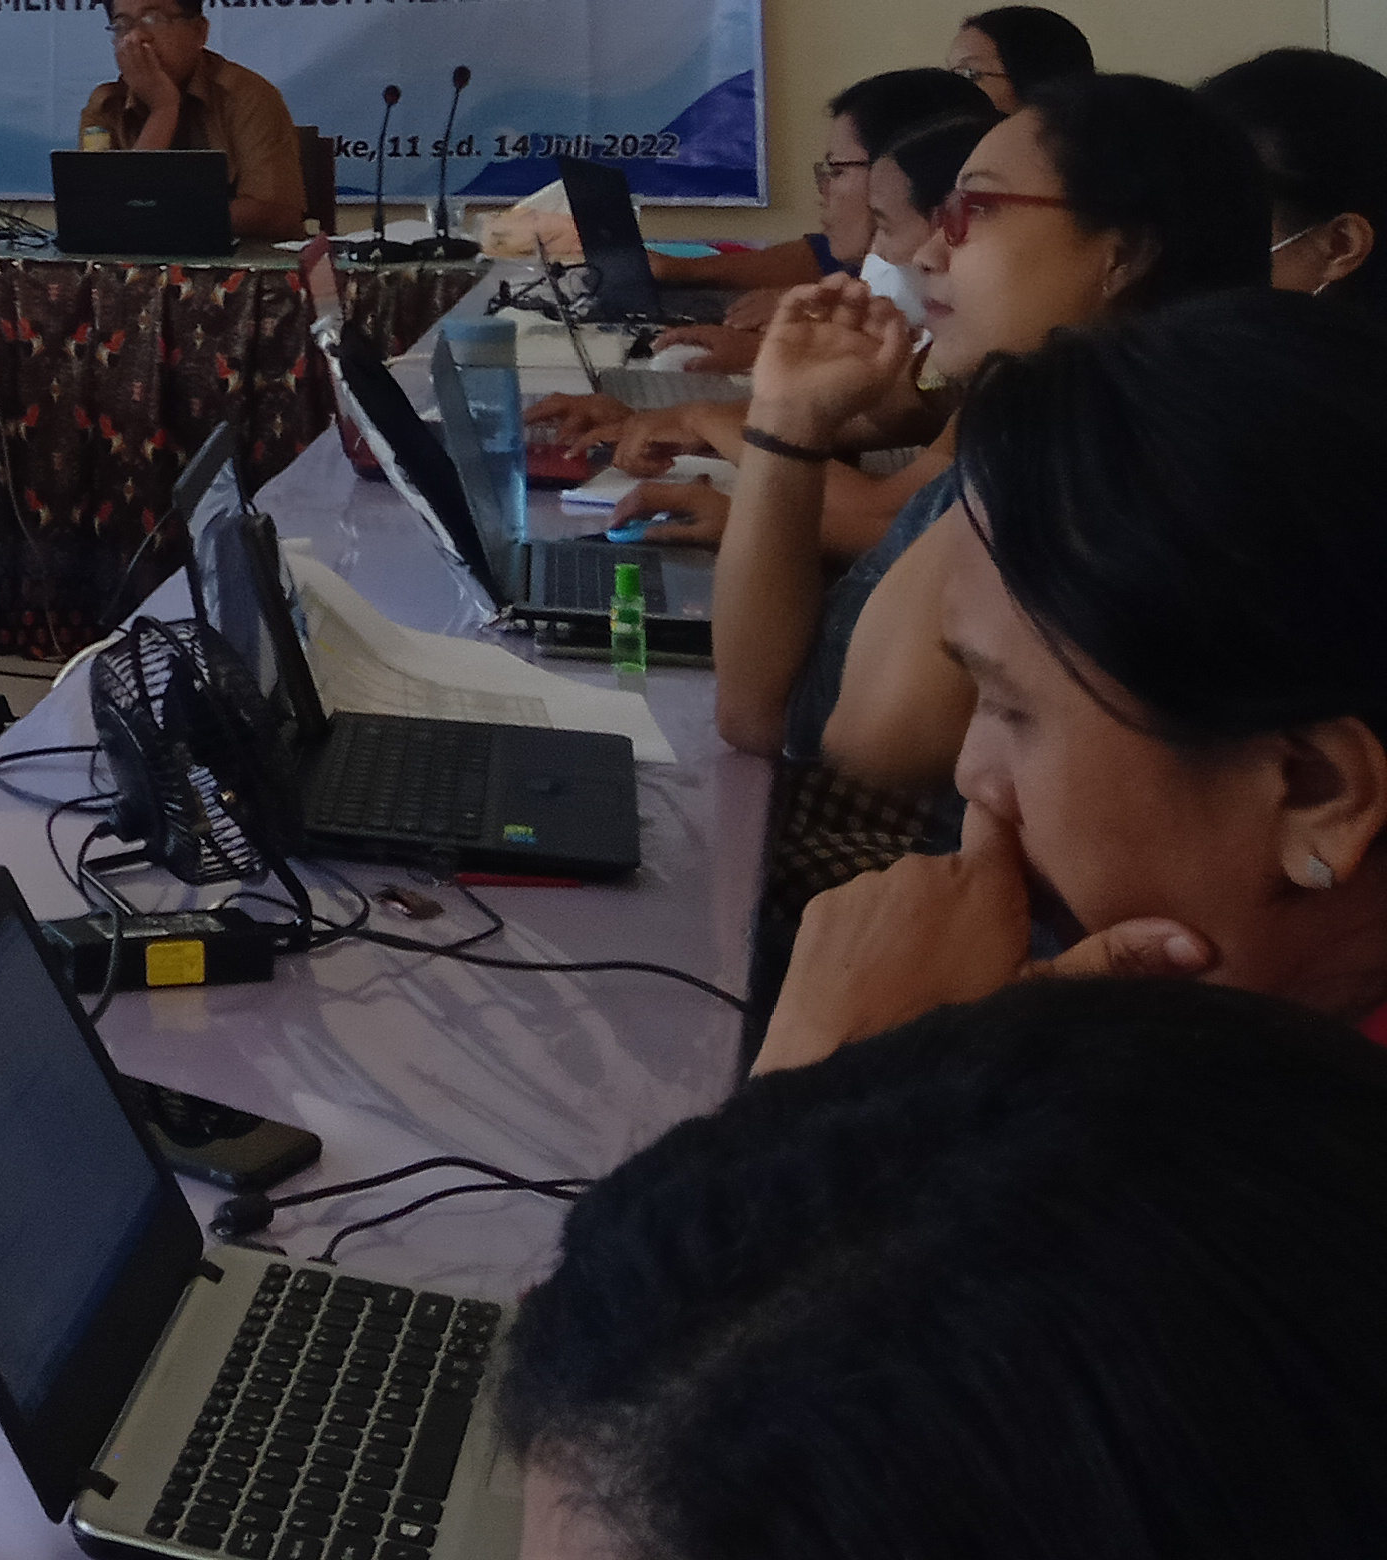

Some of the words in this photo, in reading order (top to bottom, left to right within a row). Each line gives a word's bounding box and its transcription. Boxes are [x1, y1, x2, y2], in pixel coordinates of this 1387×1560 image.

[387, 135, 421, 158] 11
[493, 133, 532, 159] 14
[601, 131, 681, 159] 2022
